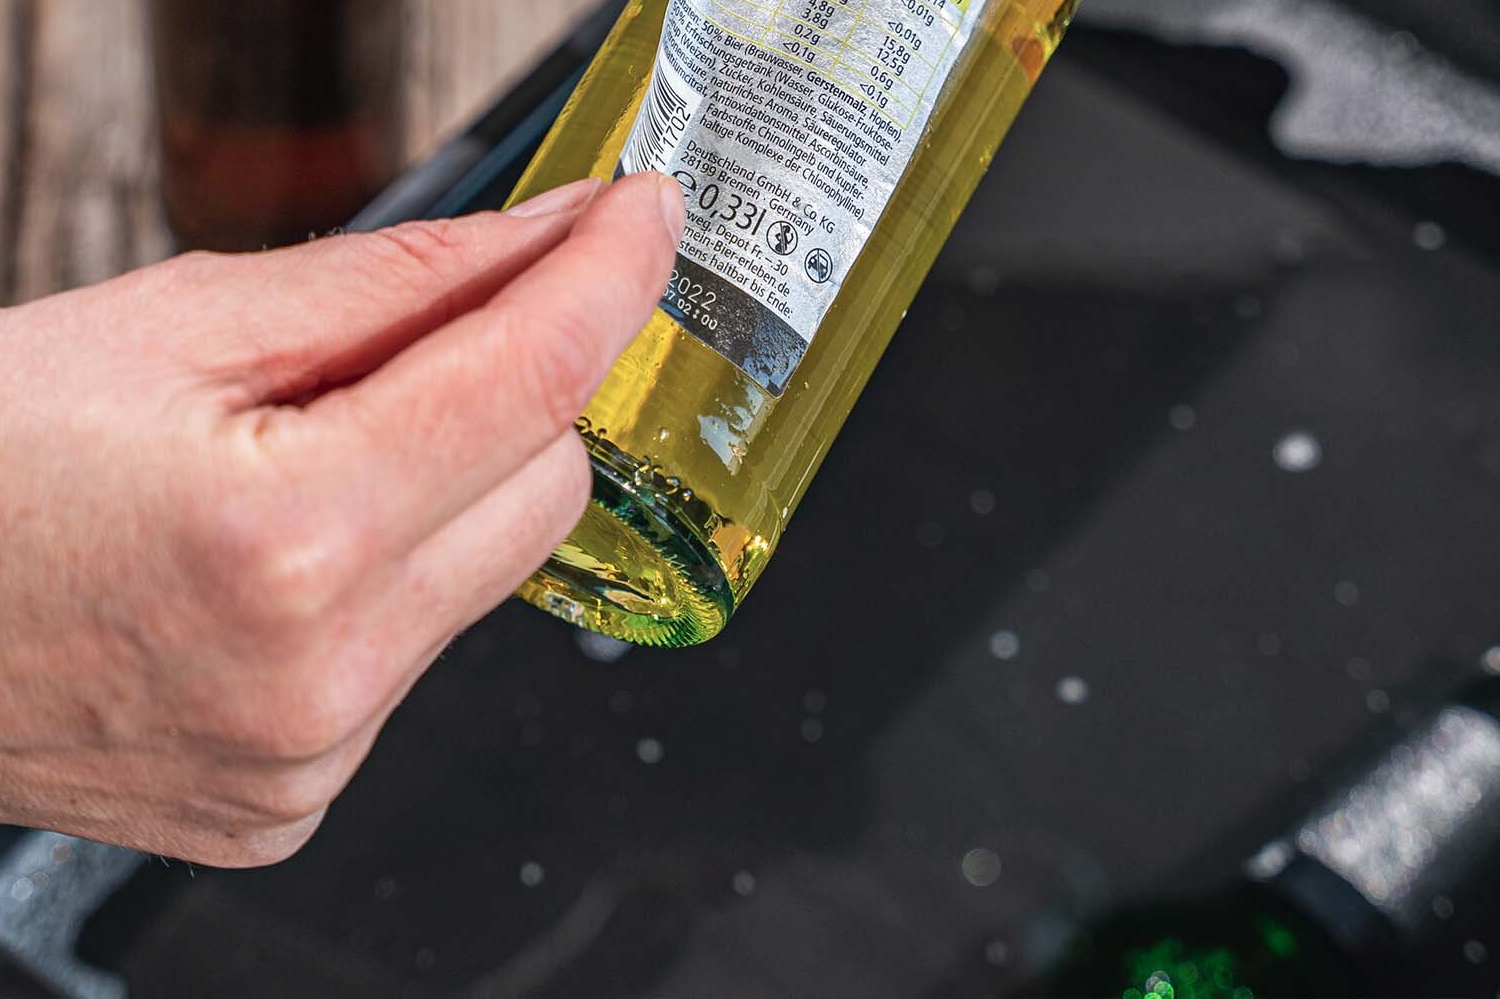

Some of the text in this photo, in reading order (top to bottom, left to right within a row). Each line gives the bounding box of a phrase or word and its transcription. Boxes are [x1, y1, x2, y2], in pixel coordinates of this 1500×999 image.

[671, 2, 893, 150] 50% Erfrischungsgetränk (Wasser, Glukose-Fruktose-
[701, 20, 723, 41] 50%
[724, 35, 744, 51] Bier
[744, 43, 805, 78] (Brauwasser,
[806, 71, 868, 117] Gerstenmalz,
[783, 41, 816, 63] <0,1g
[859, 83, 889, 109] <0,1g
[794, 24, 821, 45] 0,2g
[870, 65, 894, 91] 0,6g
[802, 7, 829, 30] 3,8g
[876, 48, 905, 77] 12,5g
[882, 35, 911, 65] 15,8g
[888, 21, 922, 51] <0,01g
[681, 34, 890, 166] (Weizen), Zucker, Kohlensäure, Säuerungsmittel
[709, 91, 810, 144] Antioxidationsmittel
[808, 139, 869, 189] Ascorbinsäure,
[710, 76, 765, 104] natürliches
[765, 99, 799, 124] Aroma,
[803, 117, 867, 167] Säureregulator
[680, 151, 717, 177] 28199
[718, 171, 761, 201] Bremen
[769, 198, 815, 237] Germany
[687, 140, 836, 234] Deutschland GmbH & Co. KG
[699, 116, 865, 221] haltige Komplexe der Chlorophylline)
[706, 103, 865, 200] Farbstoffe Chinolingelb und kupfer-
[678, 240, 793, 319] stens haltbar bis Ende:
[716, 224, 751, 251] Depot
[750, 245, 763, 261] Fr.
[668, 269, 717, 311] 2022
